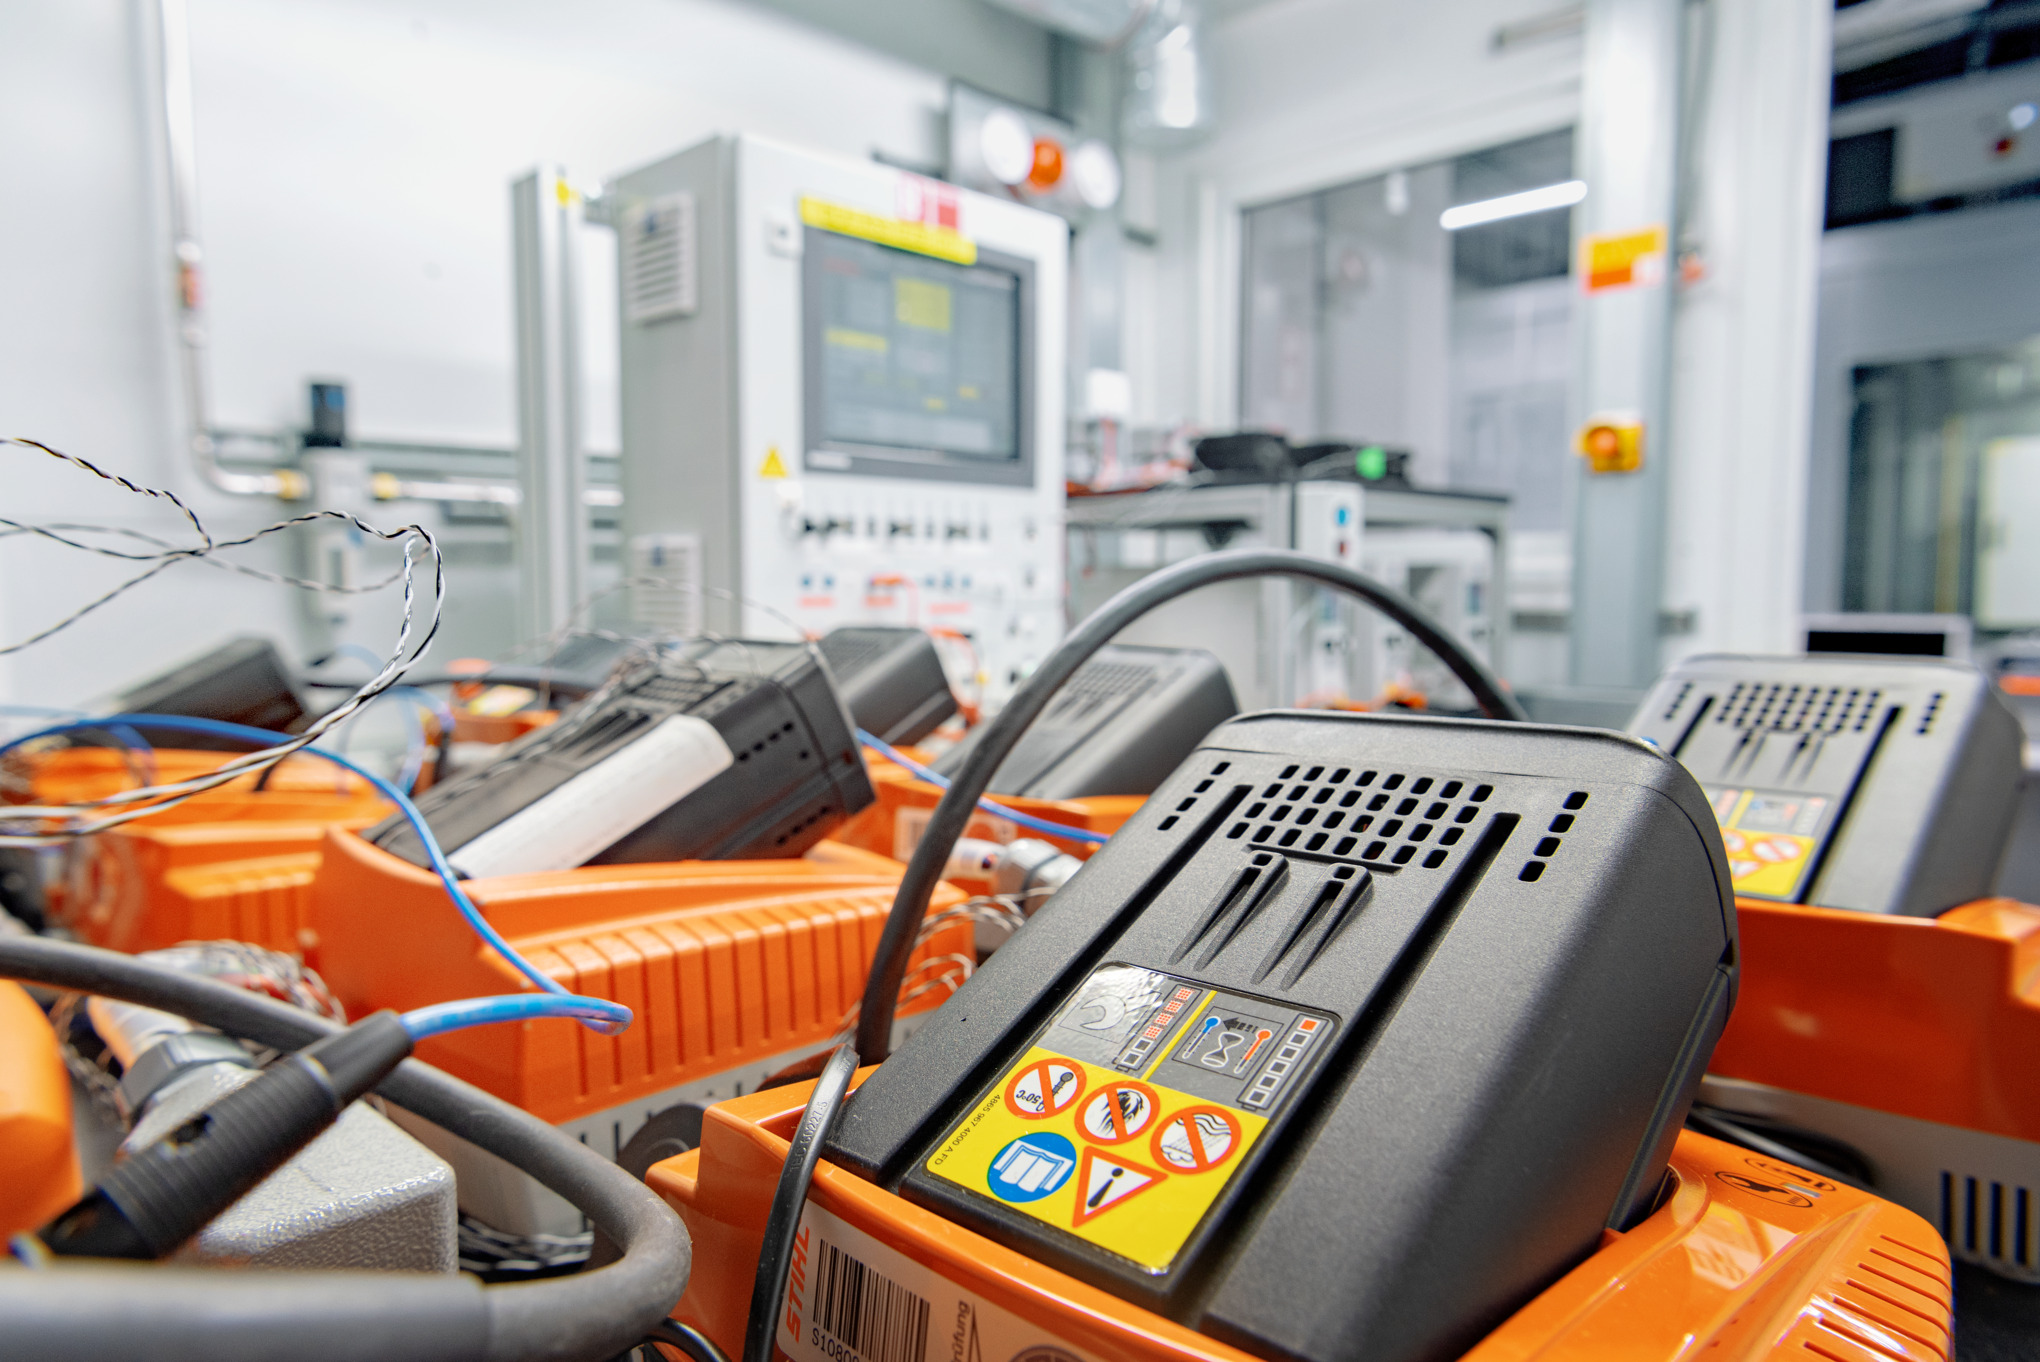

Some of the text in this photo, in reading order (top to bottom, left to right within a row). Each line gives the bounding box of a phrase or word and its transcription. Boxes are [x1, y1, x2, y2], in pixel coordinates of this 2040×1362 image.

[983, 1094, 1001, 1112] 4865
[970, 1112, 985, 1127] 967
[952, 1127, 971, 1146] 4000
[934, 1153, 948, 1165] FD
[786, 1226, 810, 1344] STIHL
[951, 1300, 970, 1362] rüfung
